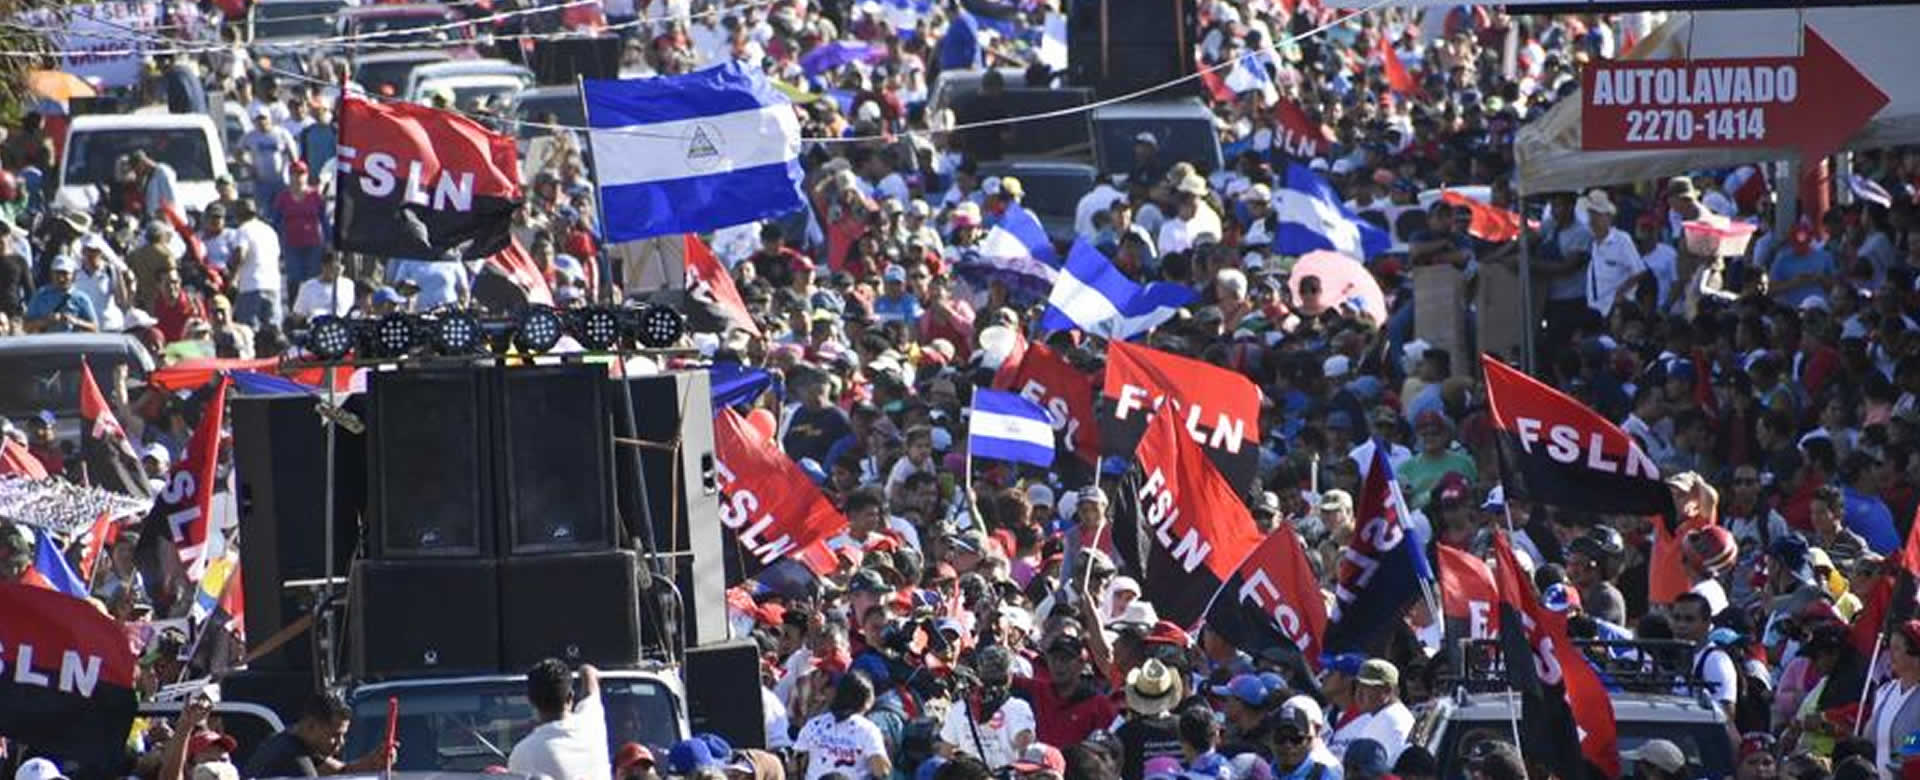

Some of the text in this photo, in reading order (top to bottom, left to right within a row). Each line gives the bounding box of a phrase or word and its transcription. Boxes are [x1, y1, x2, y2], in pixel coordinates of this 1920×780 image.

[1592, 66, 1798, 105] AUTOLAVADO
[1273, 123, 1317, 157] SLN
[1625, 107, 1766, 142] 2270-1414
[1021, 378, 1079, 452] FSL
[1515, 416, 1660, 481] FSLN
[162, 448, 208, 582] SLN
[1139, 465, 1212, 573] FSLN
[0, 642, 102, 698] LN
